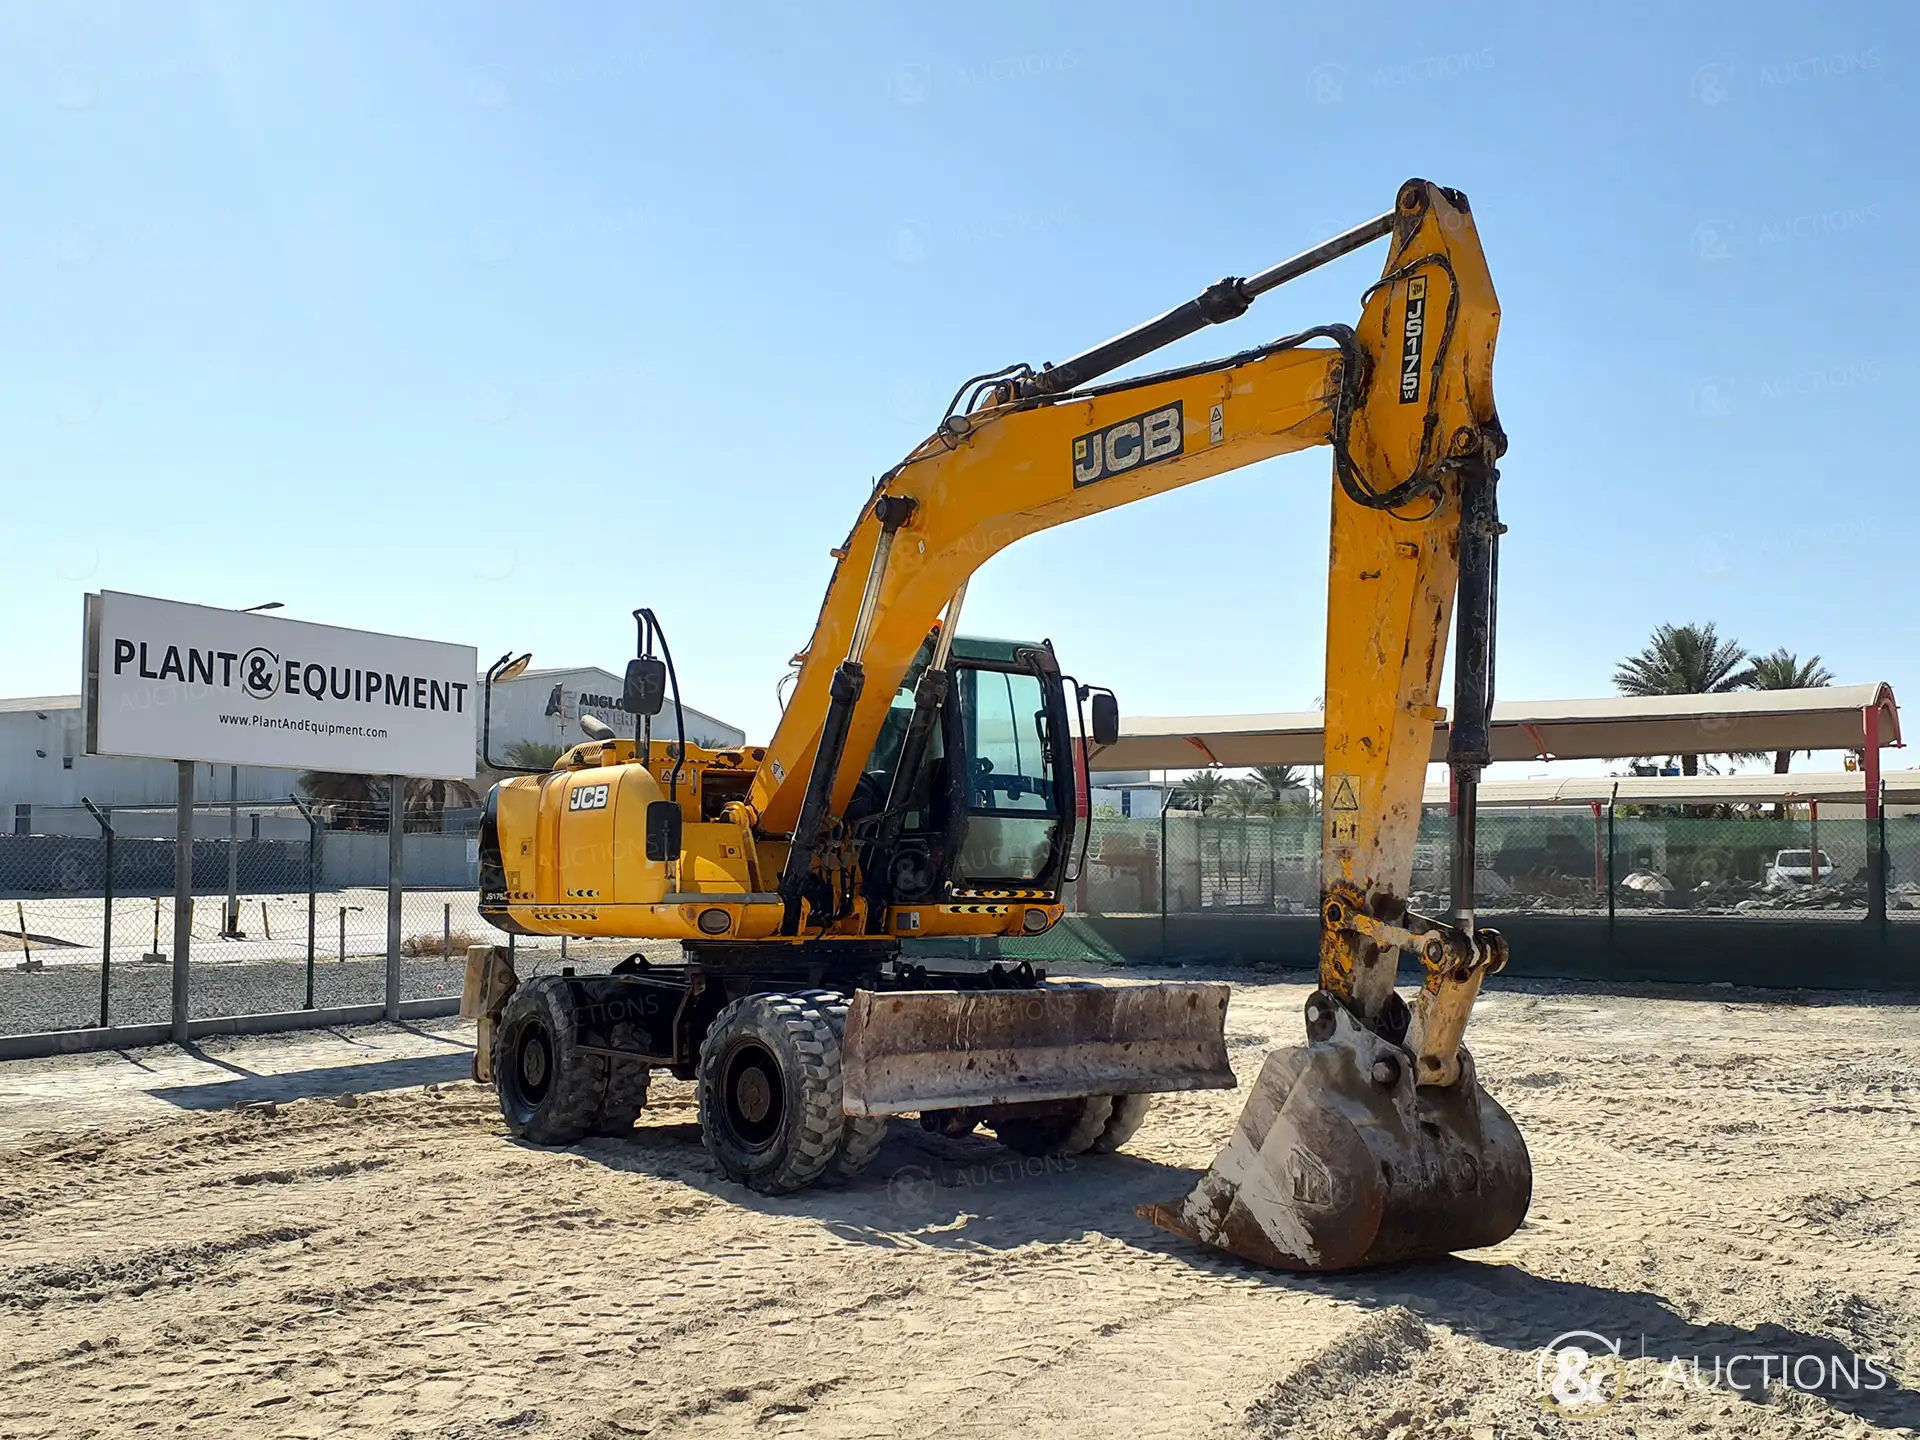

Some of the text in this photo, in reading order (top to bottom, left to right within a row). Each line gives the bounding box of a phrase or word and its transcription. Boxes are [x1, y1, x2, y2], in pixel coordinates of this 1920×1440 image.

[1075, 407, 1181, 482] JCB
[114, 638, 238, 687] PLANT
[285, 661, 468, 713] EQUIPMENT
[219, 714, 388, 739] www.PlantAndEquipment.com
[570, 785, 608, 810] JCB
